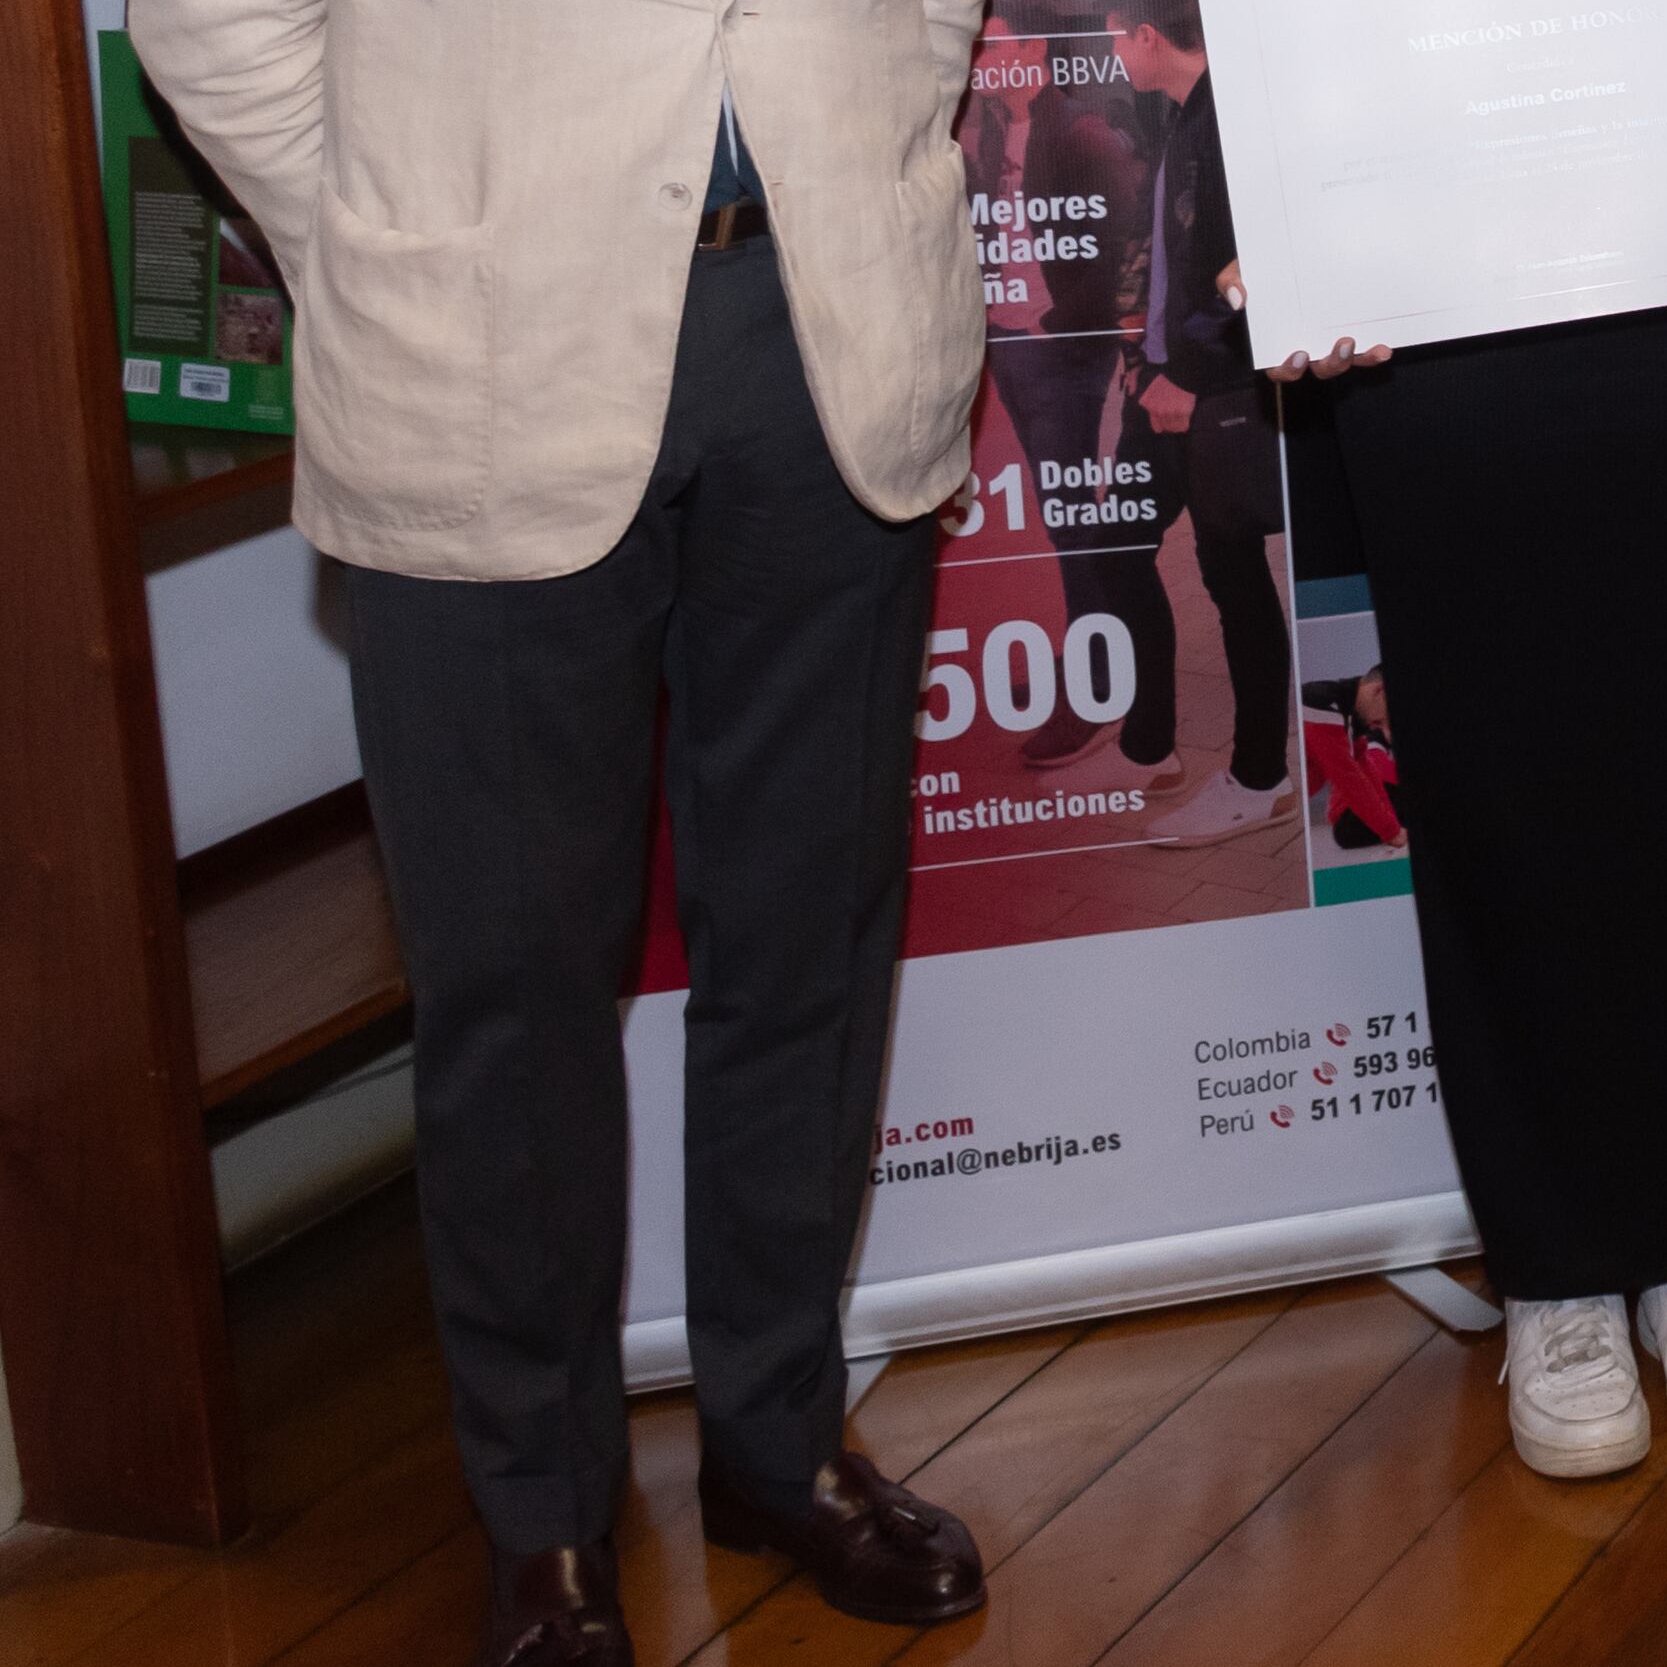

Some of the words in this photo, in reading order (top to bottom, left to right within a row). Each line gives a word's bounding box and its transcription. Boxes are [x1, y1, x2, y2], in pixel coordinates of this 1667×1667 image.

[1408, 21, 1522, 53] MENCIÓN
[1530, 17, 1562, 37] DE
[1570, 5, 1664, 31] HONOR
[971, 60, 1042, 90] ación
[1052, 55, 1130, 86] BBVA
[1464, 92, 1545, 117] Agustina
[970, 190, 1108, 232] Mejores
[1039, 456, 1152, 491] Dobles
[1043, 494, 1158, 528] Grados
[914, 612, 1137, 742] 500
[912, 771, 961, 797] on
[924, 788, 1146, 834] instituciones
[1195, 1028, 1312, 1064] Colombia
[1367, 1014, 1396, 1039] 57
[1405, 1012, 1417, 1033] 1
[1198, 1069, 1298, 1100] Ecuador
[1354, 1051, 1399, 1078] 593
[1407, 1046, 1437, 1070] 96
[1200, 1109, 1254, 1137] Perú
[1311, 1097, 1339, 1120] 51
[1350, 1093, 1361, 1115] 1
[1372, 1085, 1416, 1112] 707
[1425, 1082, 1437, 1103] 1
[869, 1132, 1122, 1186] cional@nebrija.es
